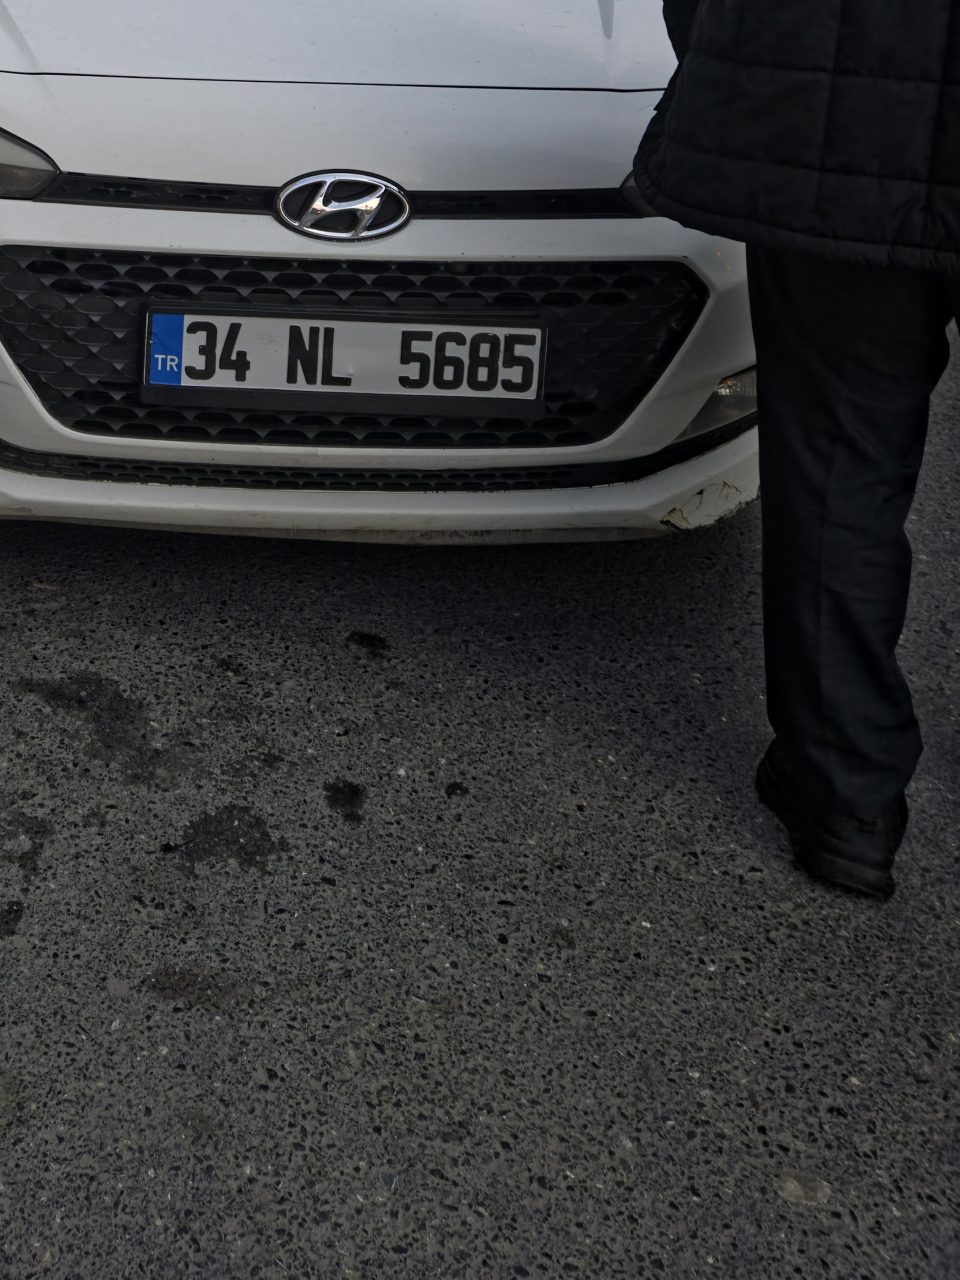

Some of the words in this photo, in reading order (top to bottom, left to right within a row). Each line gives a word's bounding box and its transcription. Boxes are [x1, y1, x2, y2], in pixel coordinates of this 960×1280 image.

[154, 353, 179, 373] TR
[183, 320, 251, 382] 34
[286, 324, 353, 387] NL
[397, 329, 538, 394] 5685
